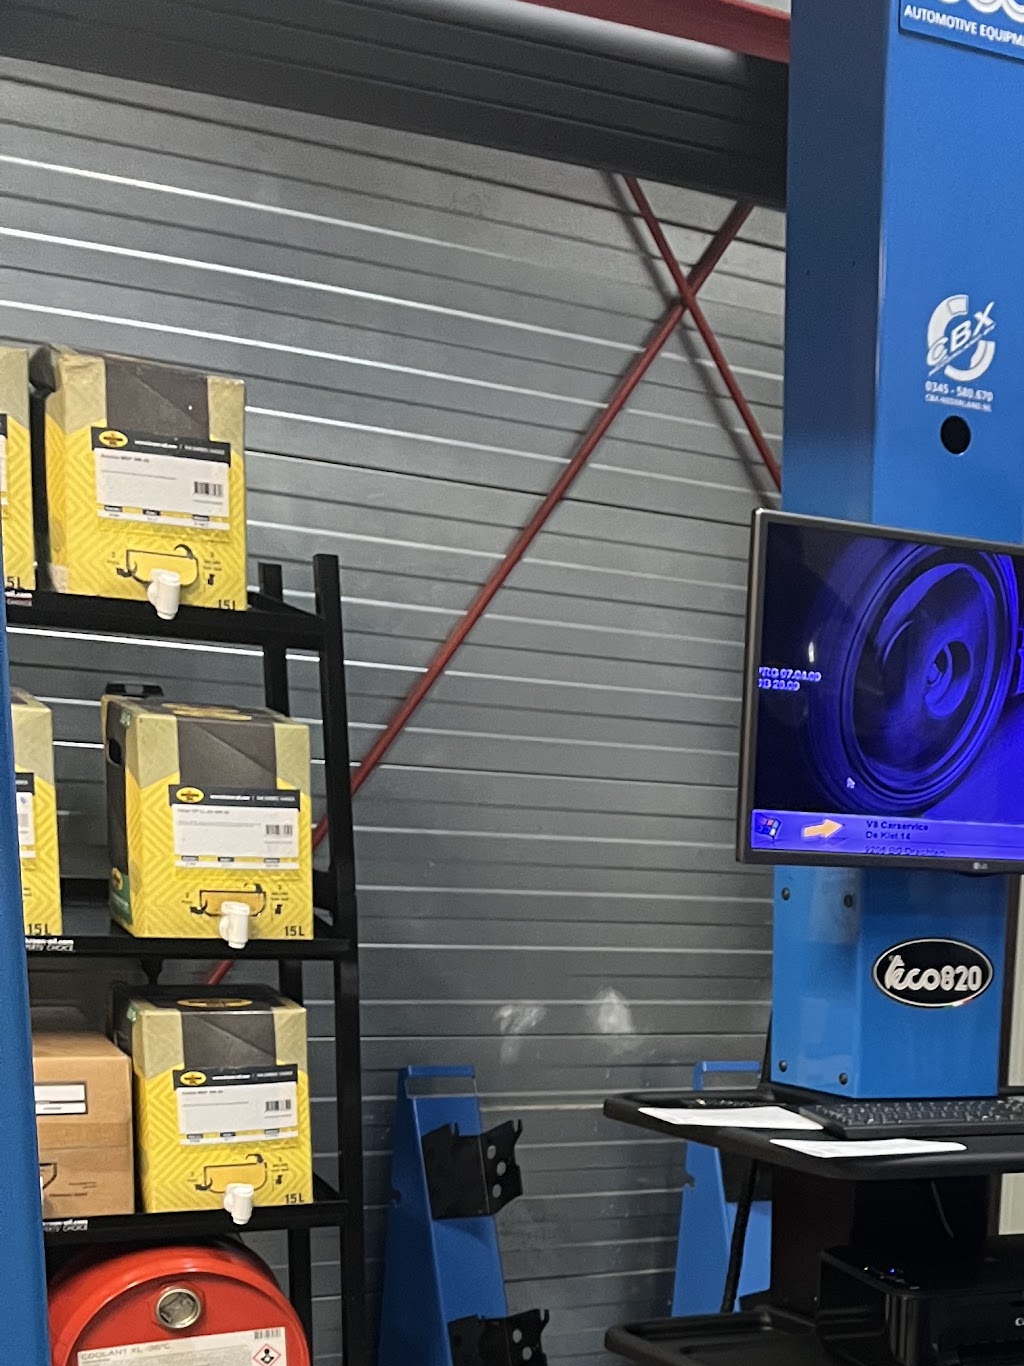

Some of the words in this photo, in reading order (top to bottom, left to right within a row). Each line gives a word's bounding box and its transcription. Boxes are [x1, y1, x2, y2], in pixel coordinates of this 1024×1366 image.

[904, 5, 977, 35] AUTOMOTIVE
[285, 926, 305, 936] 15L
[285, 1193, 304, 1204] 15L
[81, 1347, 128, 1361] COOLANT
